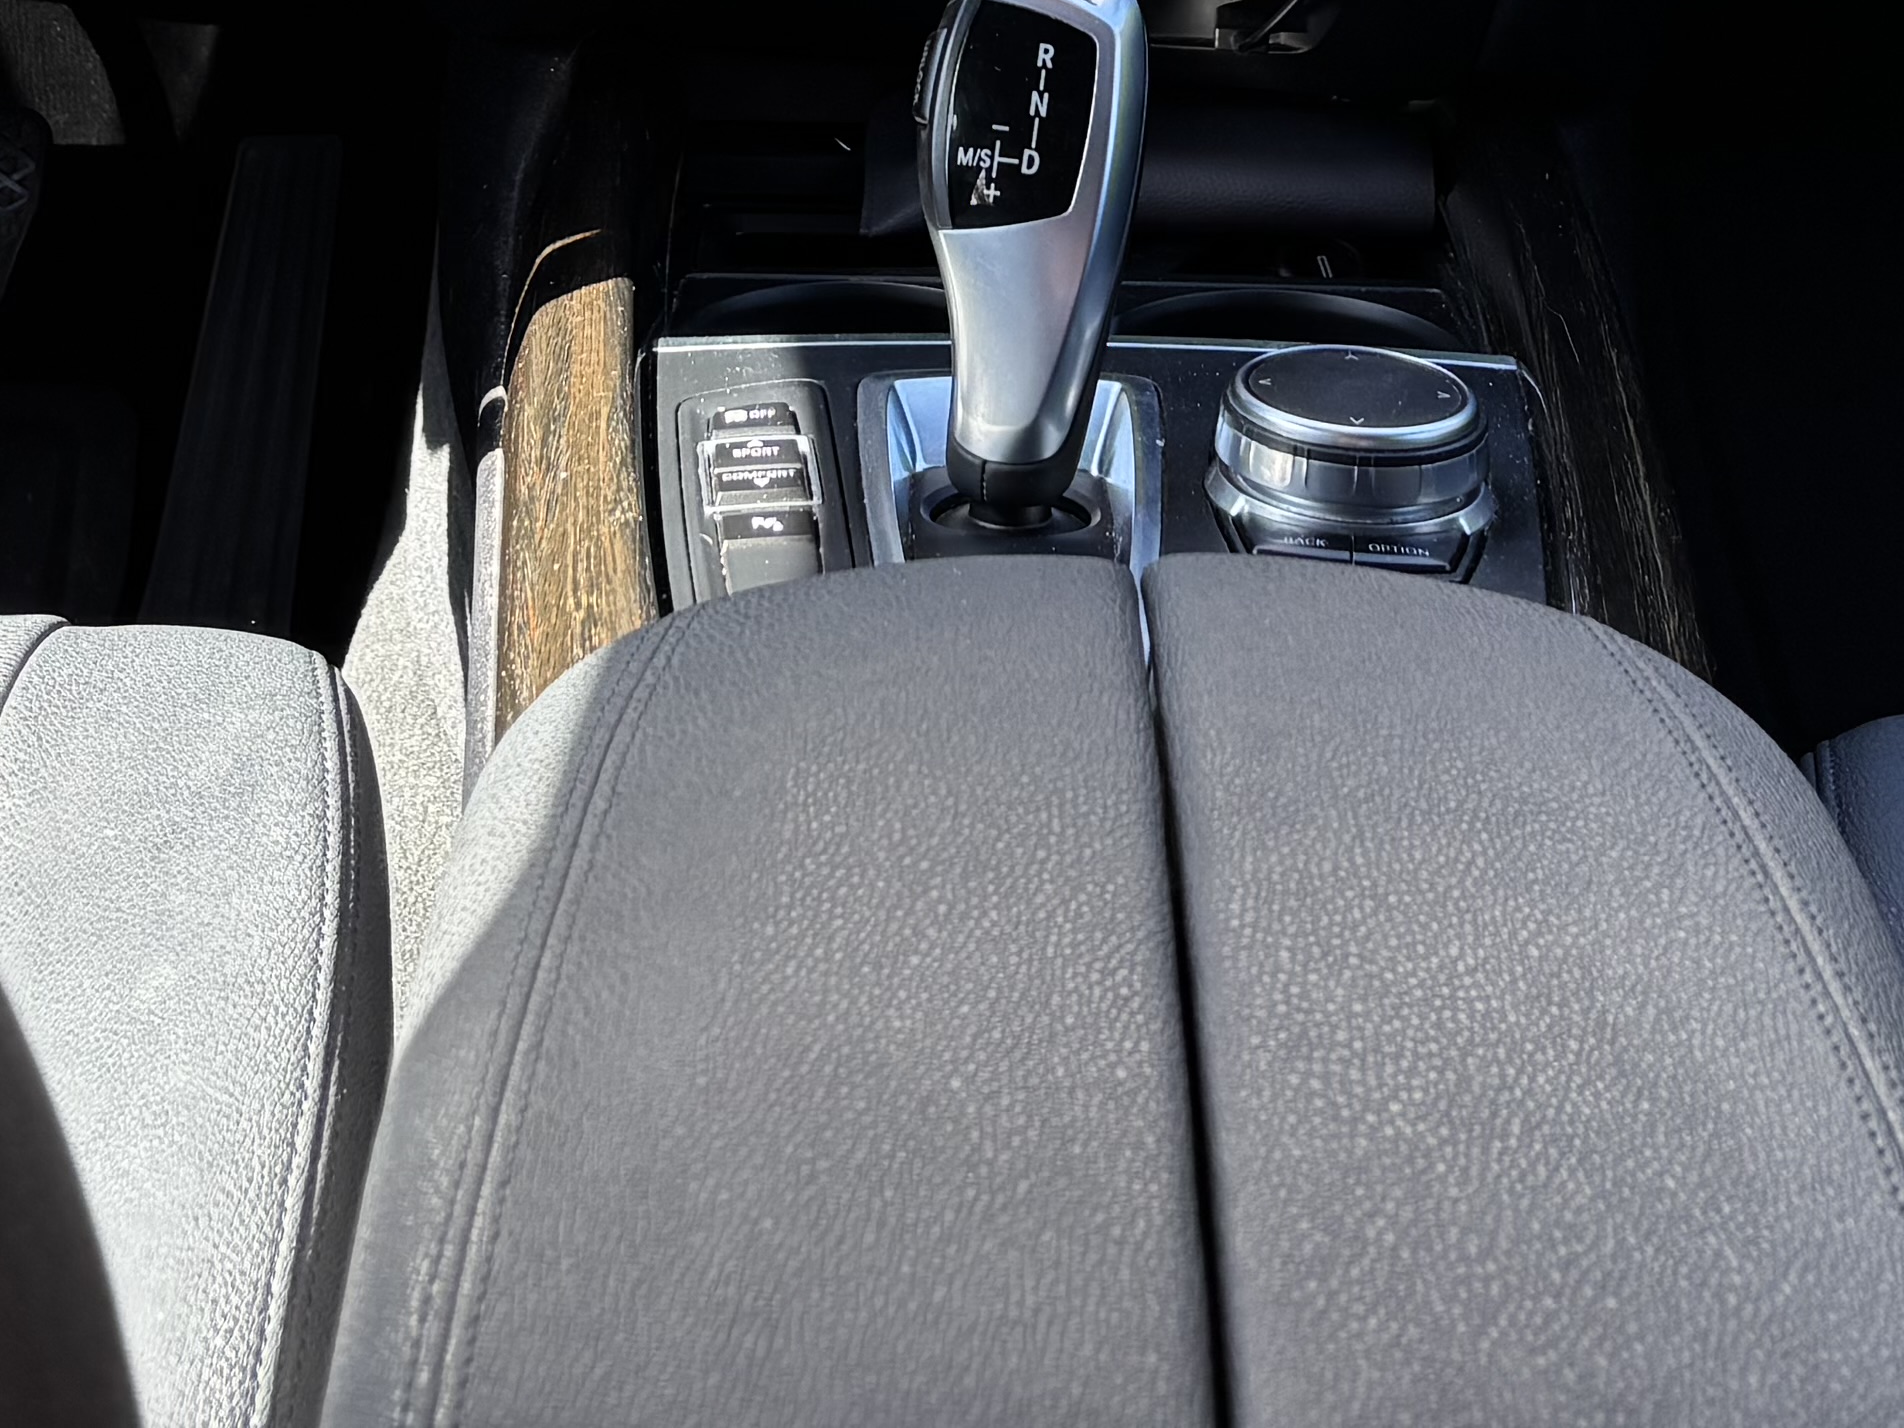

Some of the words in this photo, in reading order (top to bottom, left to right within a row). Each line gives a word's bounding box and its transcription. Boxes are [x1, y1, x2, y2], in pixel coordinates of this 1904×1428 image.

[1036, 43, 1055, 69] R
[1029, 90, 1049, 118] N
[957, 146, 992, 169] M/S
[1020, 148, 1040, 175] D
